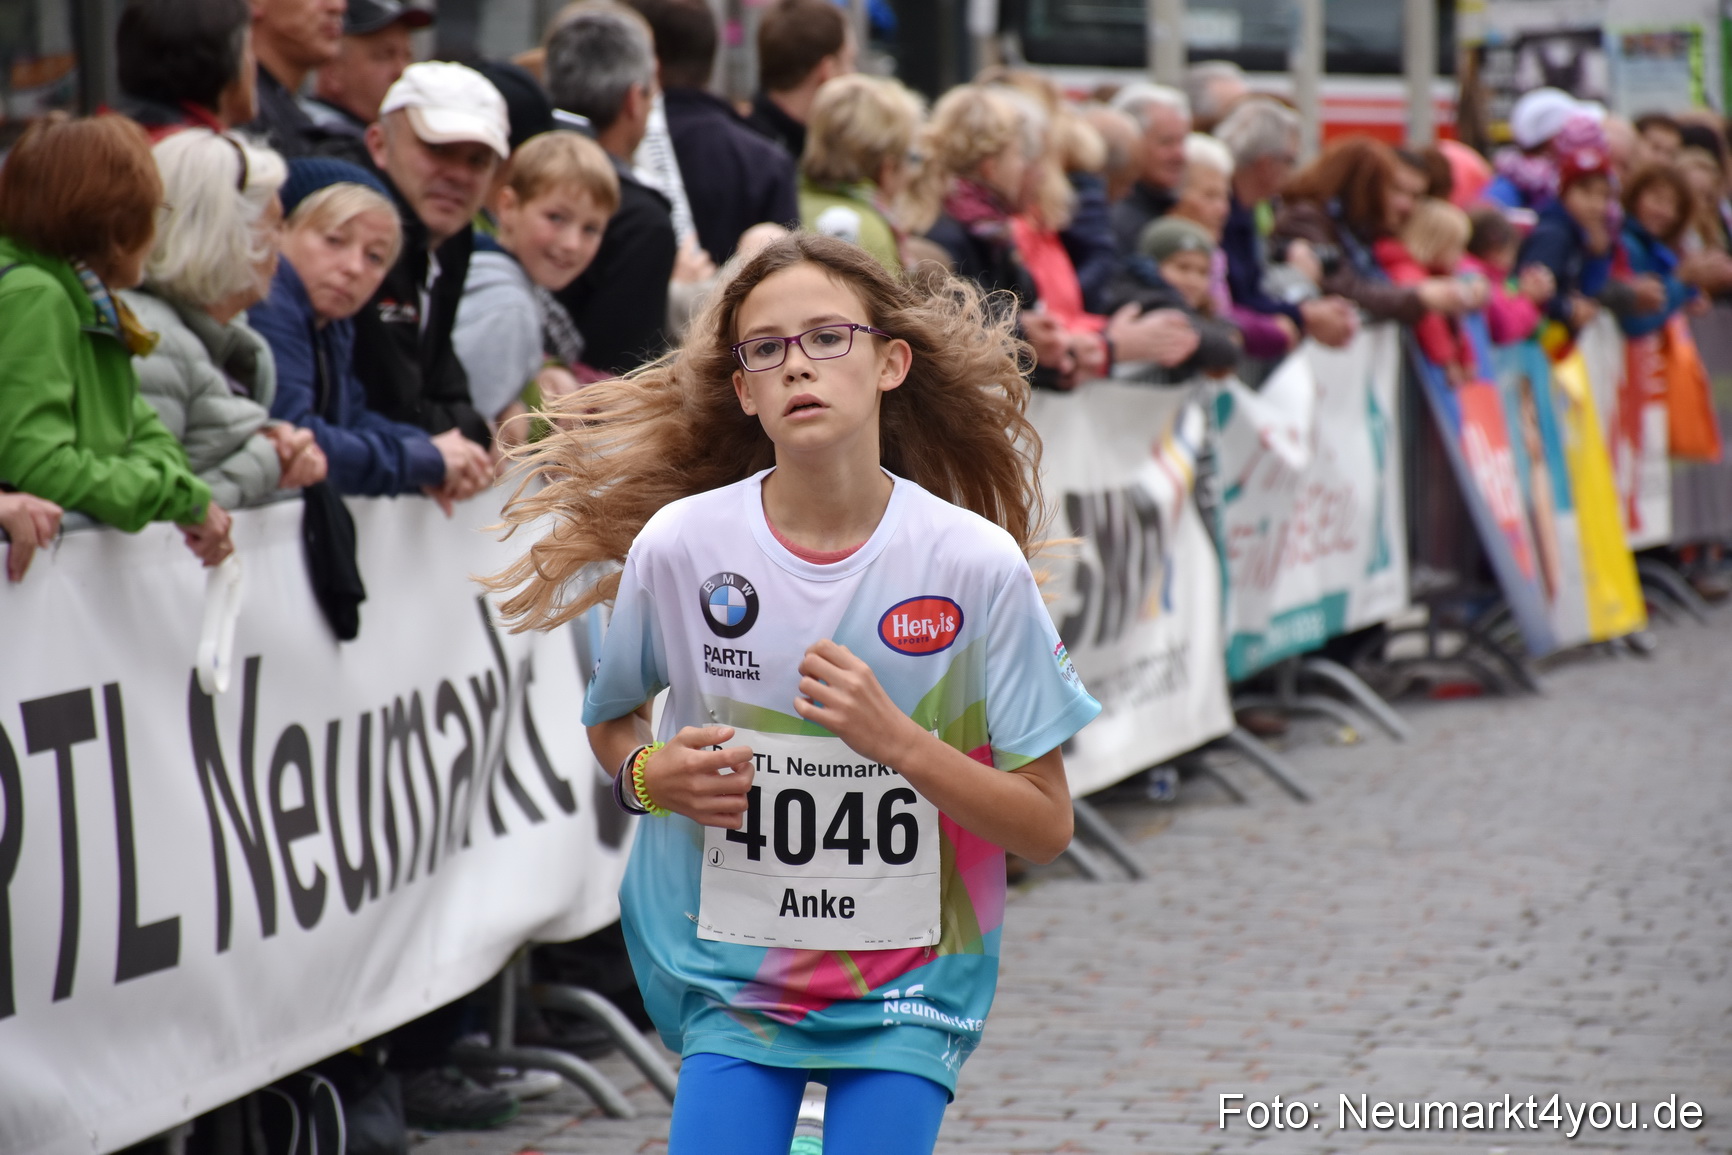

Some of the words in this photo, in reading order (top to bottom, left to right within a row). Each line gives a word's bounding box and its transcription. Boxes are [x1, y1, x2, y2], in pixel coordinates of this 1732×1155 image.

[703, 574, 755, 597] BMW
[892, 612, 955, 639] Hervis
[898, 637, 930, 645] SPORTS
[704, 644, 760, 668] PARTL
[704, 662, 760, 681] Neumarkt
[188, 595, 577, 955] Neumarkt
[726, 785, 919, 866] 4046
[712, 850, 720, 864] J
[779, 888, 855, 920] Anke
